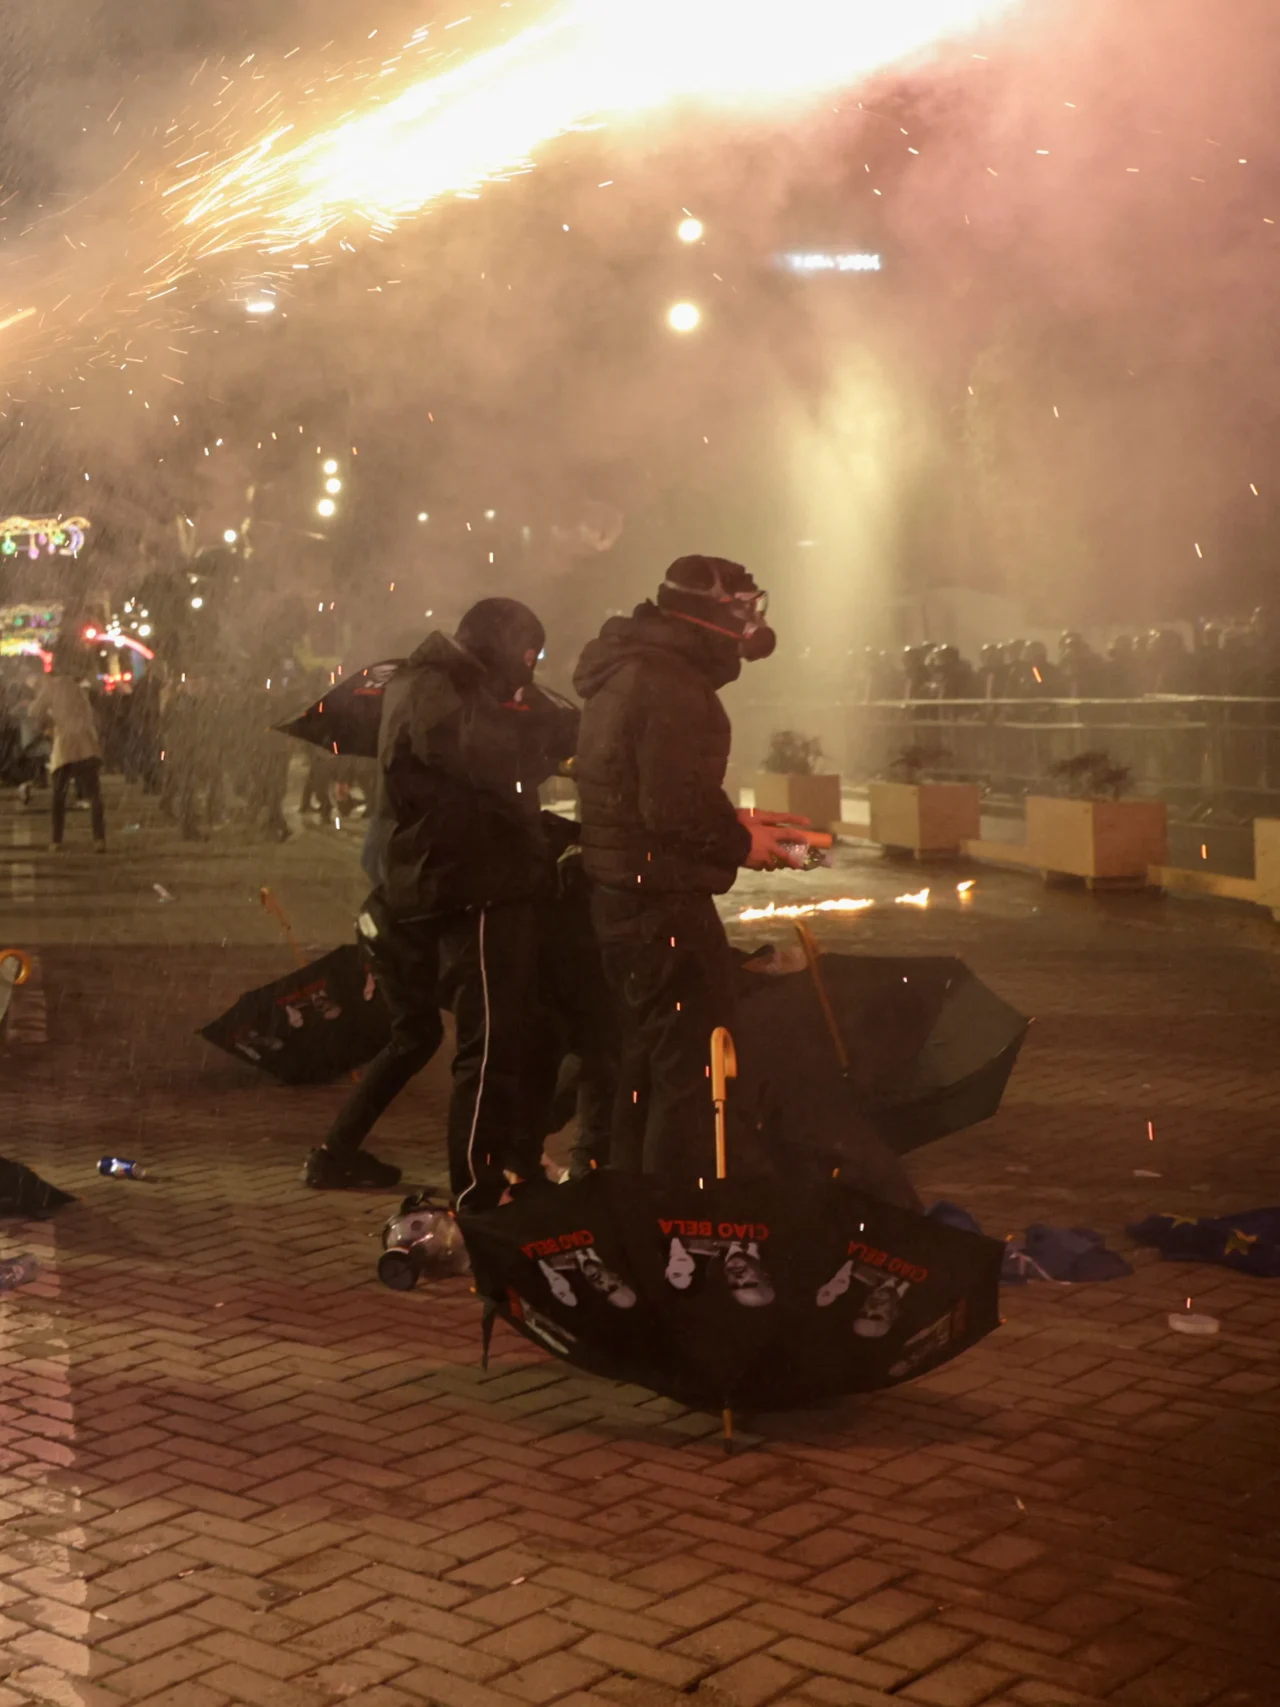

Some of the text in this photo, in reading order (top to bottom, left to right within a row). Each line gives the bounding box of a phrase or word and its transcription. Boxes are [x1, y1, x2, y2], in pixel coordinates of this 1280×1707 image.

[658, 1218, 770, 1241] CIAO BELA
[888, 1257, 928, 1283] CIAO
